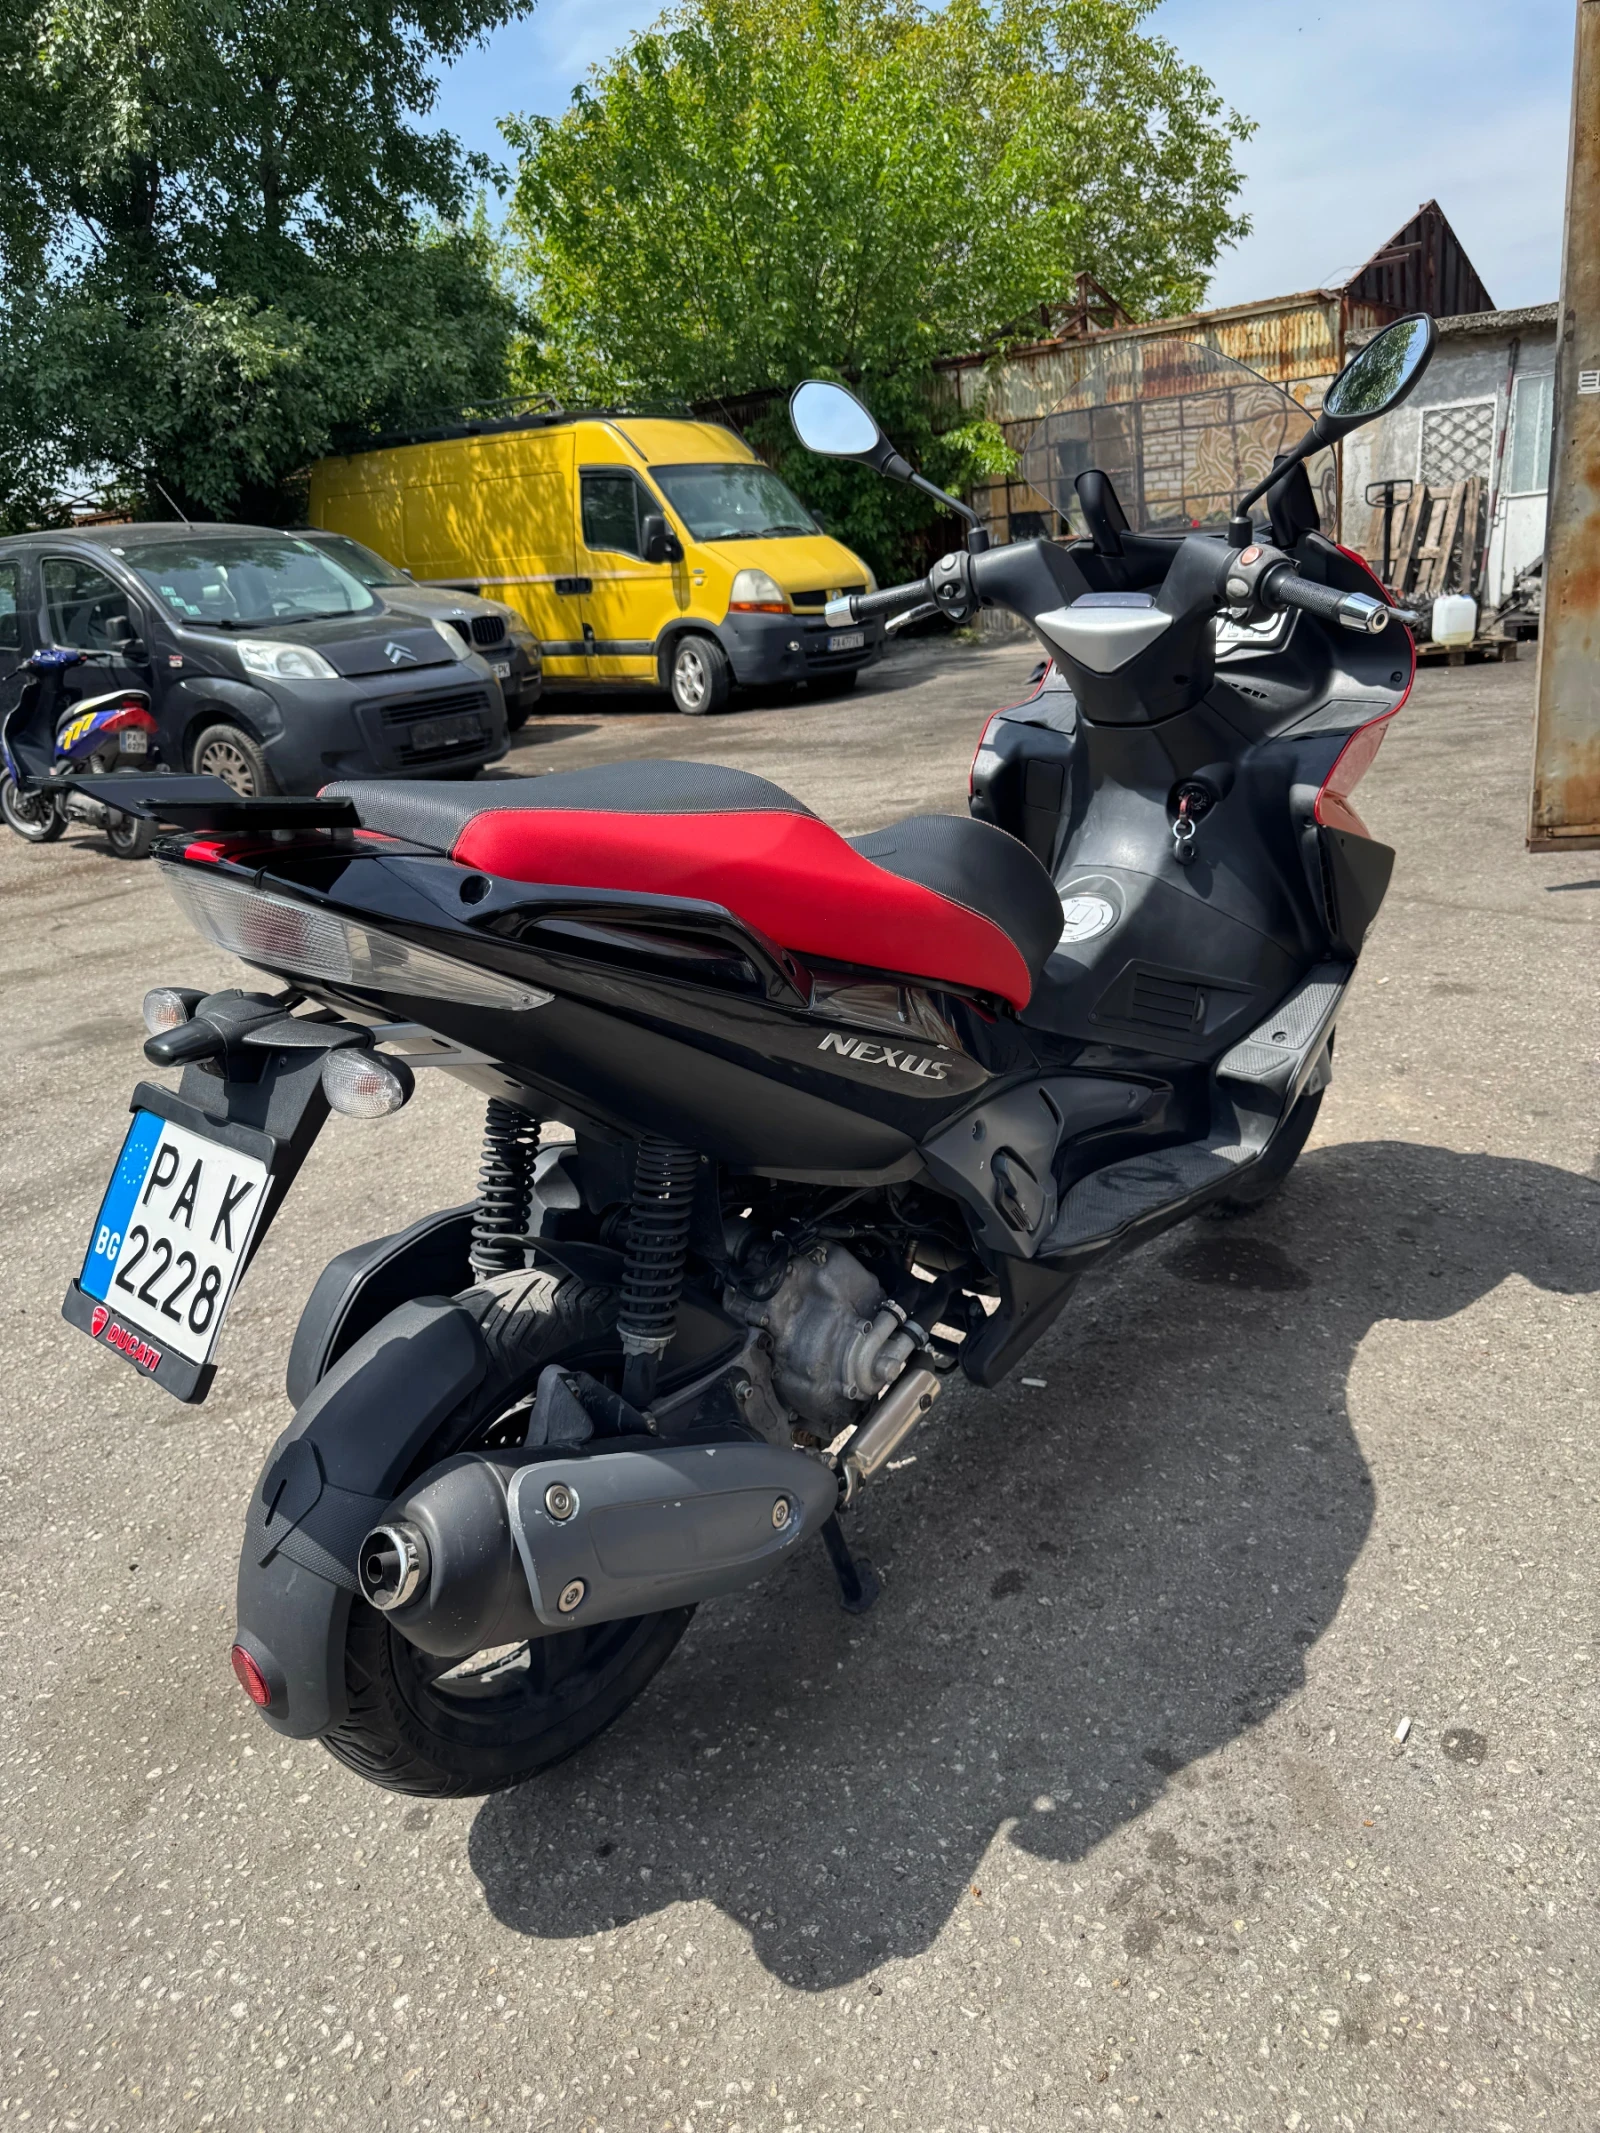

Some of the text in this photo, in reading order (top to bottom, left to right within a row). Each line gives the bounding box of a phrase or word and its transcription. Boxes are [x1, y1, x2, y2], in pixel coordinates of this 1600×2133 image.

[817, 1032, 953, 1080] NEXUS
[95, 1225, 121, 1261] BG
[115, 1224, 223, 1336] 2228
[106, 1323, 162, 1373] DUCATI
